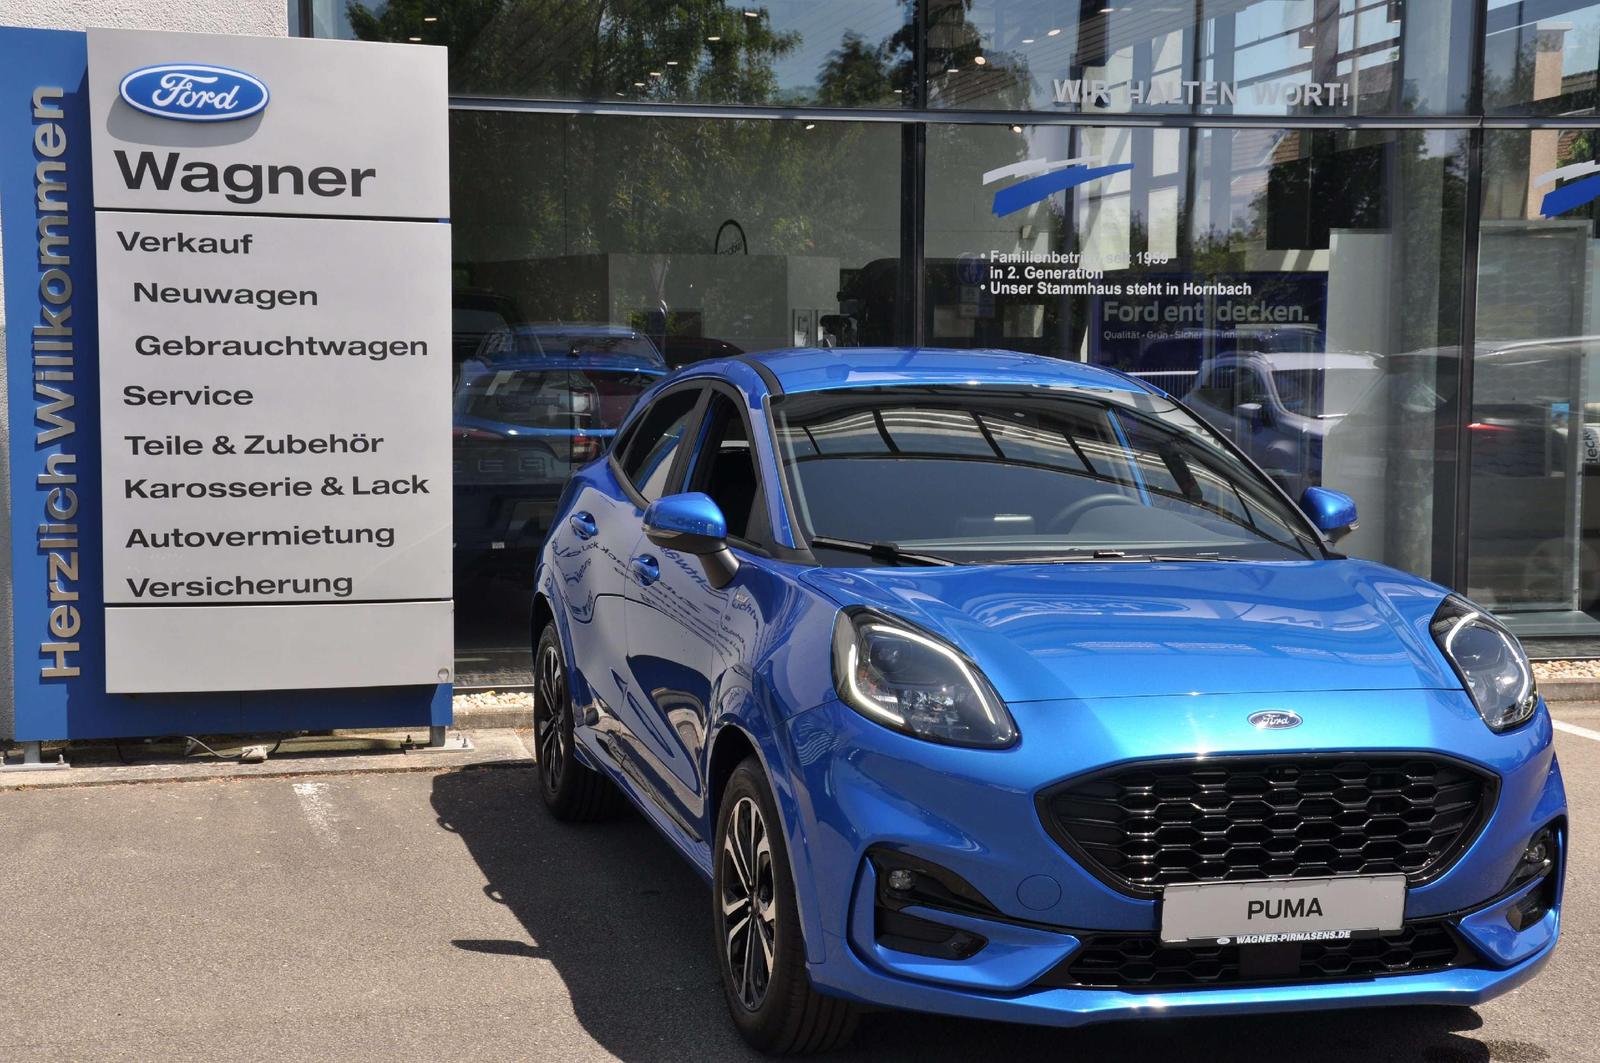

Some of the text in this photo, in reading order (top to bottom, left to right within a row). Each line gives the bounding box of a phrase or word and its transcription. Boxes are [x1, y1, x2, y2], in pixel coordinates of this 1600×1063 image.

[151, 72, 240, 110] Ford
[1053, 79, 1349, 107] WIR HALTEN WORT!
[113, 150, 376, 204] Wagner
[116, 230, 253, 255] Verkauf
[990, 266, 1103, 279] in 2. Generation
[133, 282, 318, 310] Neuwagen
[990, 281, 1252, 297] Unser Stammhaus steht in Hornbach
[1104, 301, 1158, 321] Ford
[1104, 330, 1140, 340] Qualität
[1146, 330, 1168, 339] Grün
[135, 336, 428, 361] Gebrauchtwagen
[33, 86, 81, 678] Herzlich Willkommen
[123, 386, 254, 406] Service
[124, 434, 385, 456] Teile & Zubehör
[124, 475, 430, 499] Karosserie & Lack
[125, 525, 395, 548] Autovermietung
[125, 576, 353, 598] Versicherung
[1247, 897, 1324, 920] PUMA
[1236, 930, 1351, 944] WAGNER-PIRMASENS.DE
